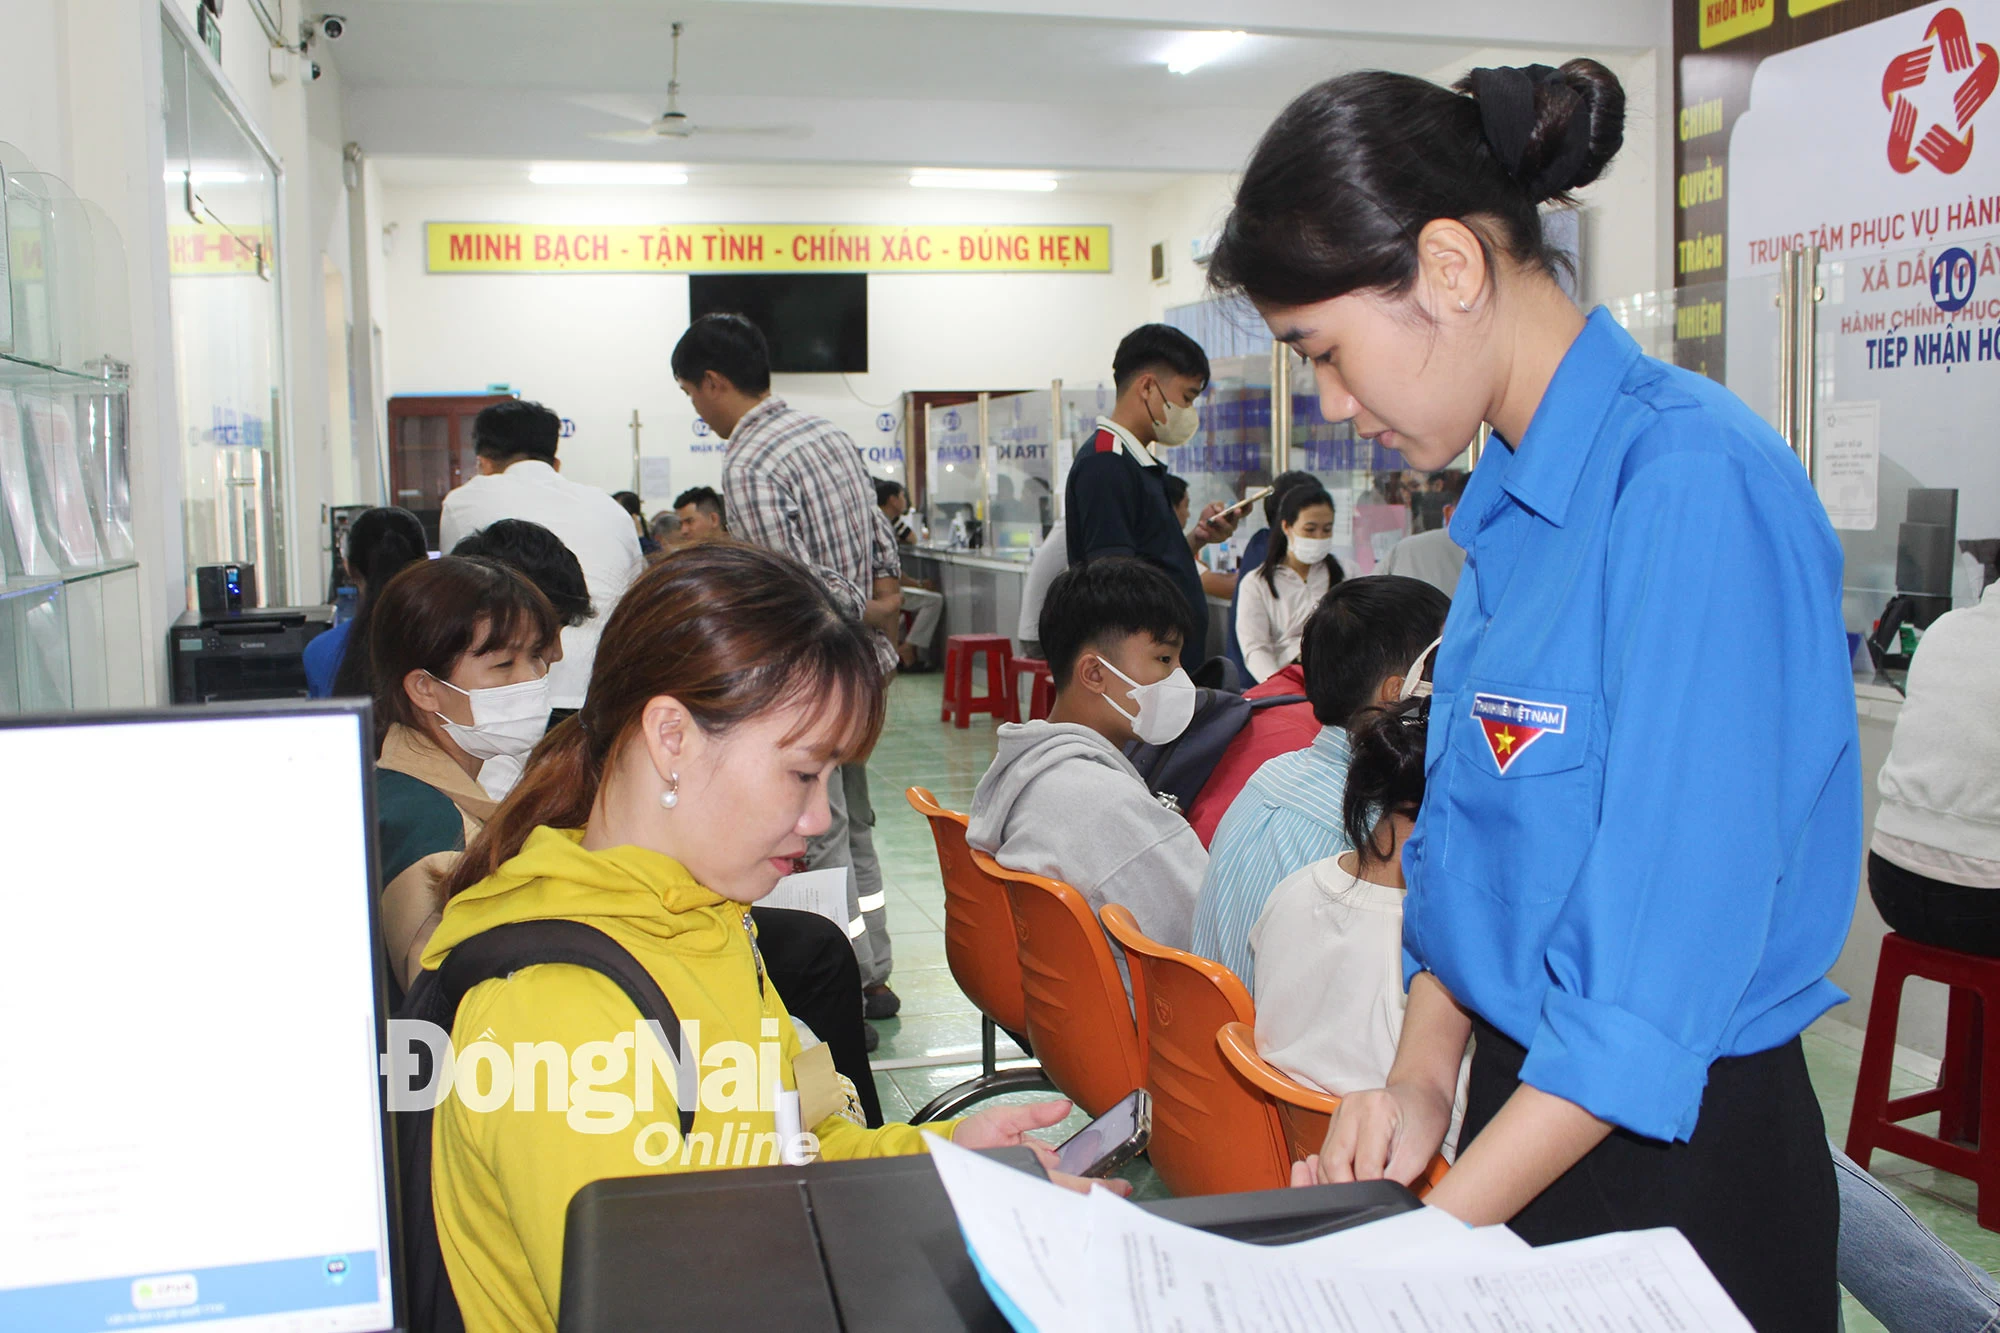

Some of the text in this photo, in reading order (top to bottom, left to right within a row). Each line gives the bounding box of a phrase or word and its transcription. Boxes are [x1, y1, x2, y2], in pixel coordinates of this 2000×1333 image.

[1680, 98, 1723, 141] CHÍNH
[1679, 155, 1723, 208] QUYỀN
[450, 233, 521, 262] MINH
[534, 234, 609, 267] BẠCH
[640, 228, 692, 267] TẬN
[702, 227, 764, 262] TÌNH
[792, 228, 871, 262] CHÍNH
[881, 228, 932, 262] XÁC
[959, 228, 1030, 262] ĐÚNG
[1039, 235, 1090, 267] HẸN
[1809, 222, 1843, 253] TÂM
[1850, 213, 1905, 249] PHỤC
[1911, 206, 1939, 241] VỤ
[1679, 231, 1723, 274] TRÁCH
[1861, 258, 1890, 293] XÃ
[1934, 257, 1972, 303] 10
[1677, 297, 1722, 343] NHIỆM
[1841, 311, 1886, 335] HÀNH
[1891, 302, 1945, 330] CHÍNH
[1866, 325, 1909, 370] TIẾP
[1914, 322, 1970, 373] NHẬN
[1531, 710, 1560, 725] NAM
